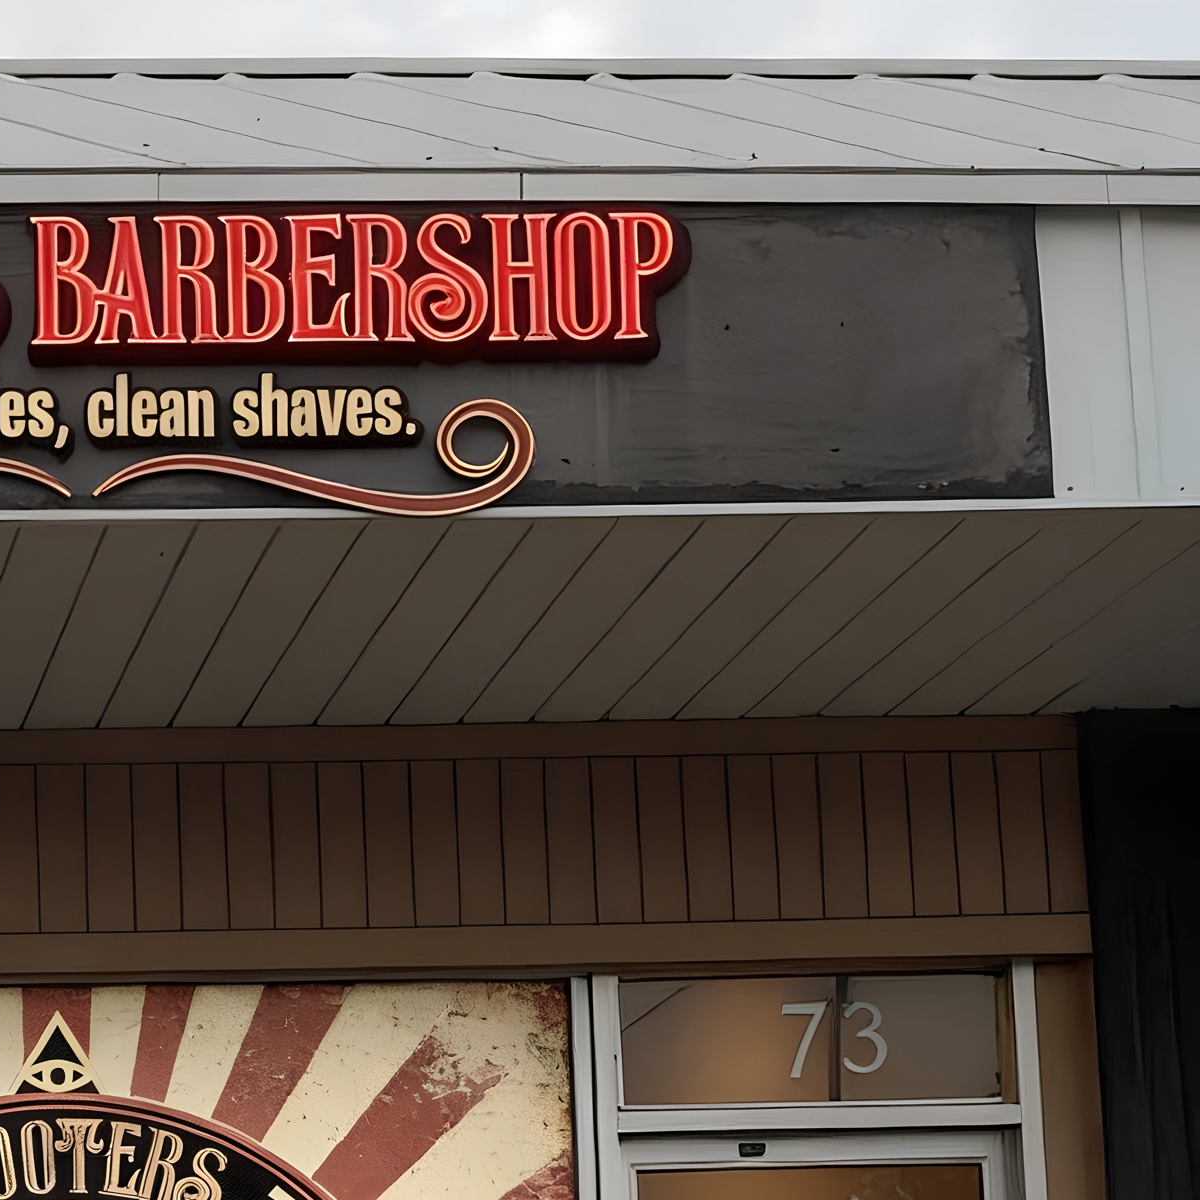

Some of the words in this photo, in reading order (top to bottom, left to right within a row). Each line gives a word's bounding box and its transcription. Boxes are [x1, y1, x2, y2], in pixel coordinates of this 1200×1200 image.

[31, 212, 675, 346] BARBERSHOP
[86, 374, 215, 438] clean
[232, 373, 417, 438] shaves.
[781, 1001, 888, 1079] 73
